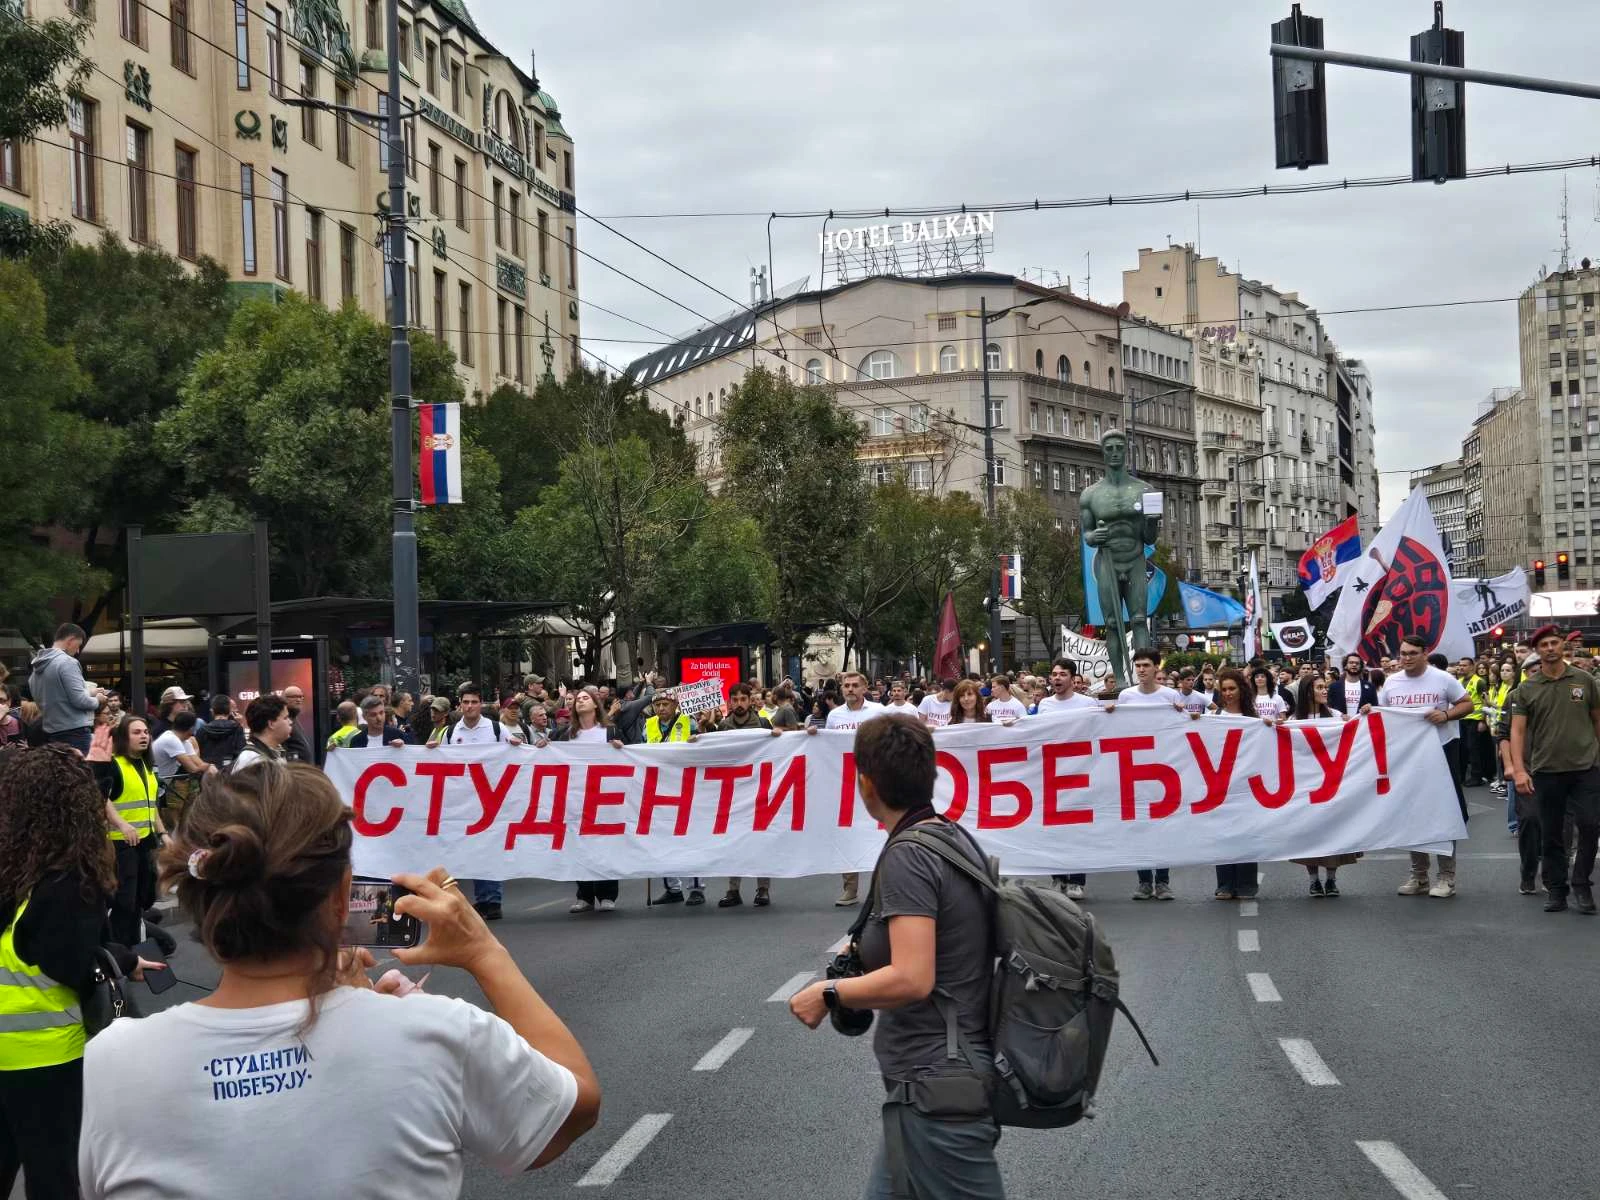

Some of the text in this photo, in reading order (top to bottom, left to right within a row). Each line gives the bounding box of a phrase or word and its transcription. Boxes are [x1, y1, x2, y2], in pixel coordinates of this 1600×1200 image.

[817, 211, 995, 255] HOTEL BALKAN
[699, 661, 714, 671] bolji
[352, 754, 807, 851] СТУДЕНТИ
